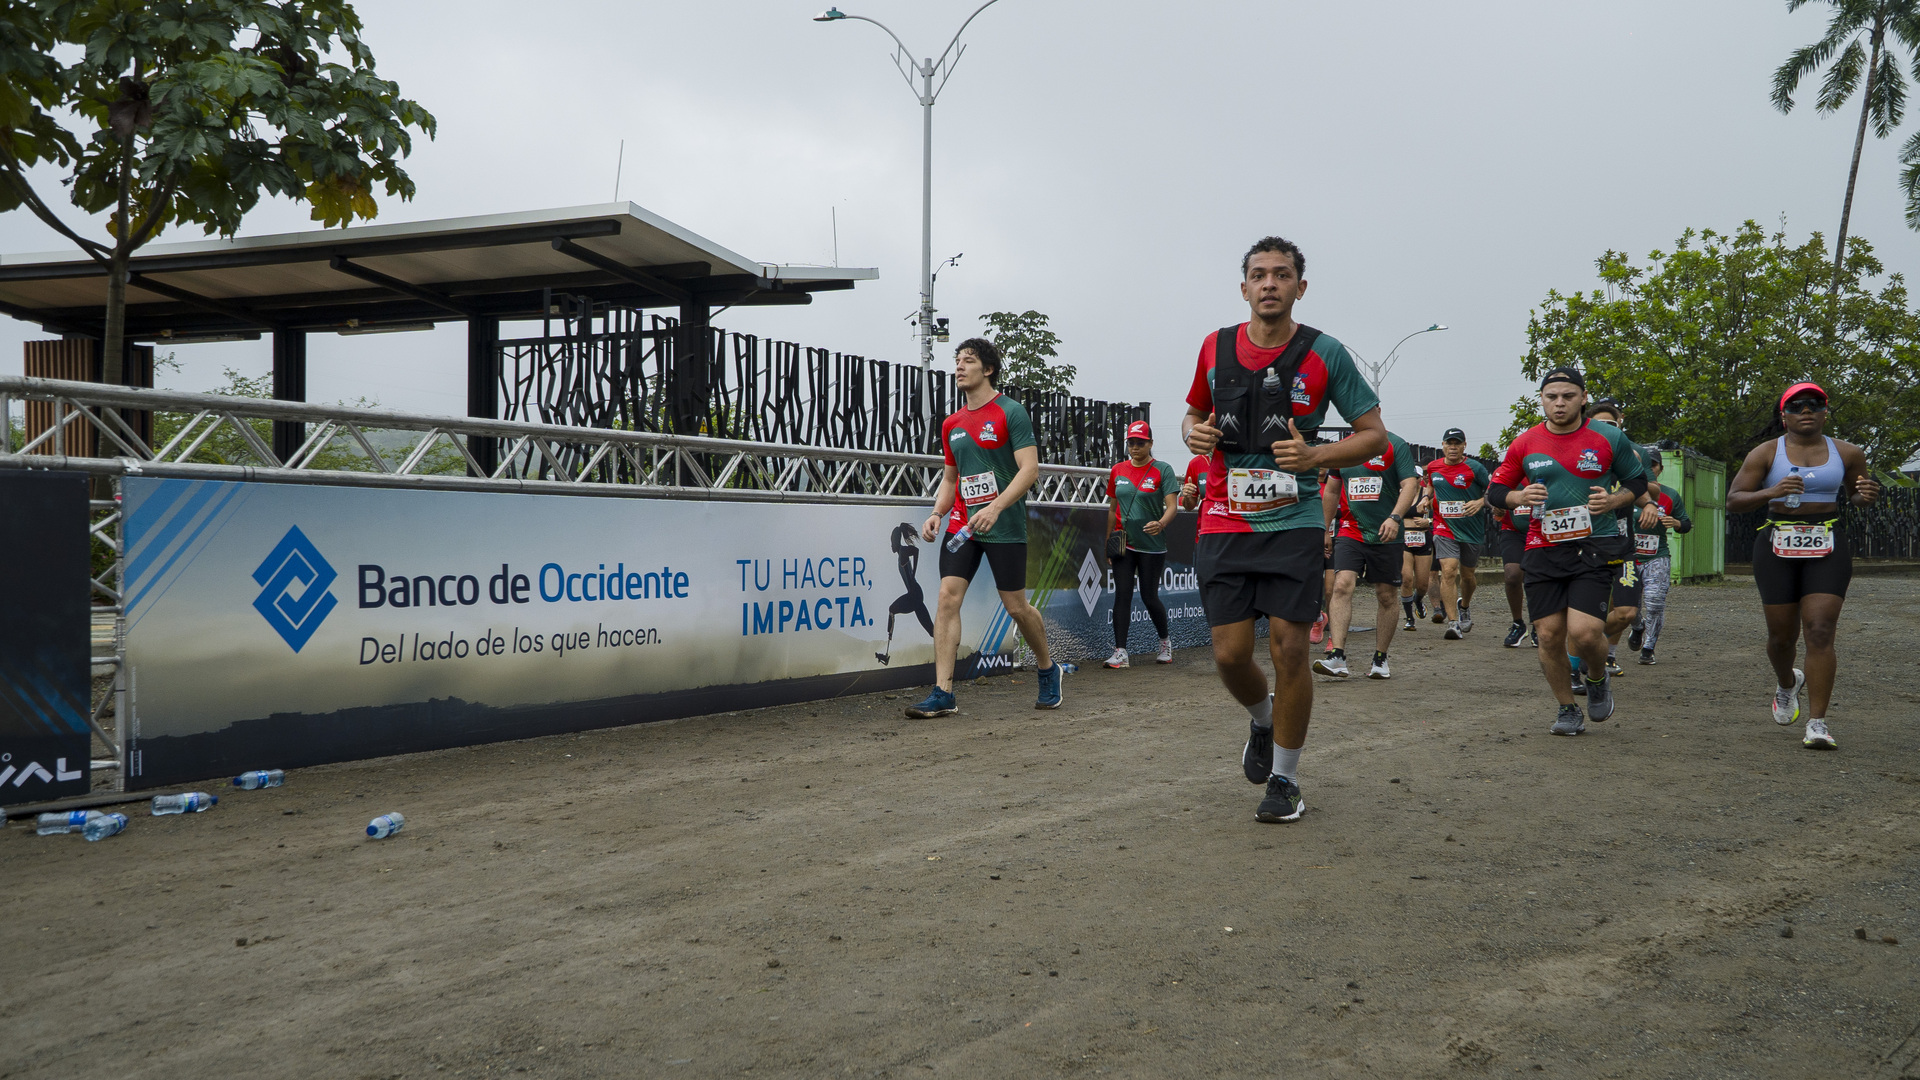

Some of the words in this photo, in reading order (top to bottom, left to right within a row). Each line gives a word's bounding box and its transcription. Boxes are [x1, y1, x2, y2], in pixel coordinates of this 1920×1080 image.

[965, 482, 990, 497] 1379
[1245, 483, 1277, 499] 441
[1353, 484, 1376, 494] 1265
[1550, 517, 1577, 532] 347
[1783, 535, 1823, 548] 1326
[736, 559, 771, 592] TU
[783, 557, 873, 591] HACER,
[358, 564, 480, 609] Banco
[489, 563, 531, 605] de
[539, 562, 690, 603] Occidente
[742, 596, 874, 636] IMPACTA.
[1167, 607, 1183, 622] que
[359, 633, 405, 666] Del
[412, 630, 470, 662] lado
[476, 628, 506, 657] de
[512, 626, 545, 654] los
[551, 631, 591, 658] que
[596, 622, 662, 649] hacen.
[976, 655, 1012, 670] AVAL
